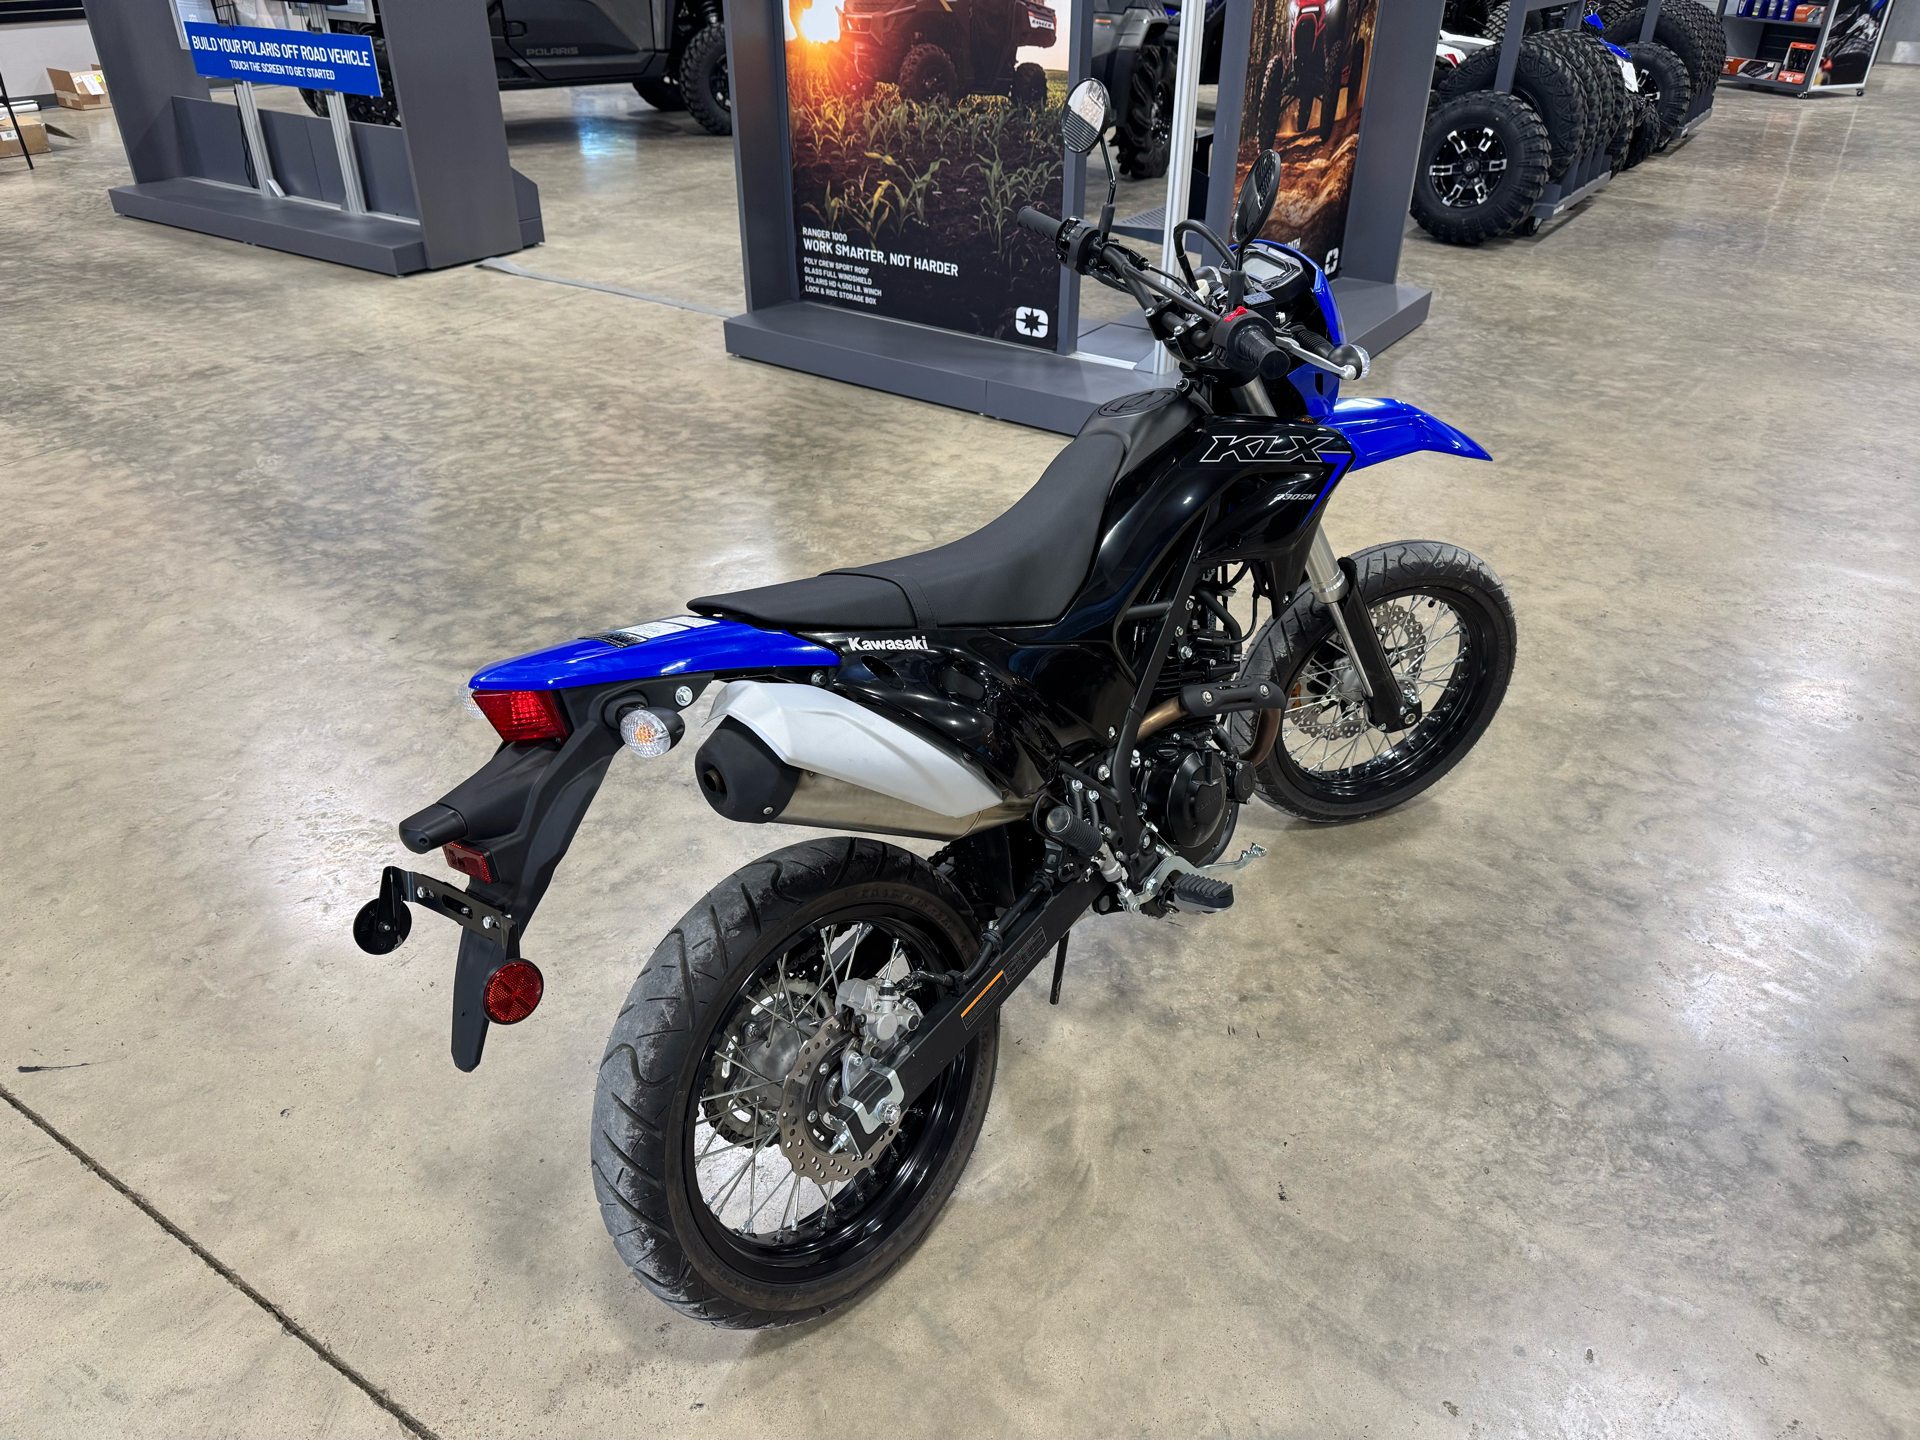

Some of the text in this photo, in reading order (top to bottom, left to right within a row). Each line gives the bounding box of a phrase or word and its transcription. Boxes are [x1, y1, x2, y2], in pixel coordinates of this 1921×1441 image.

[192, 36, 371, 66] BUILD YOUR POLARIS OFF ROAD VEHICLE
[526, 46, 579, 56] POLARIS
[230, 60, 335, 80] TOUCH THE SCREEN TO GET STARTED
[802, 227, 848, 242] RANGER 1000
[802, 238, 958, 277] WORK SMARTER, NOT HARDER
[804, 257, 870, 275] POLY CREW SPORT ROOF
[804, 267, 872, 286] GLASS FULL WINDSHIELD
[804, 276, 882, 296] POLARIS HD 4,500 LB. WINCH
[805, 285, 876, 305] LOCK & RIDE STORAGE BOX
[1199, 435, 1335, 463] KLX
[848, 636, 928, 651] Kawasaki
